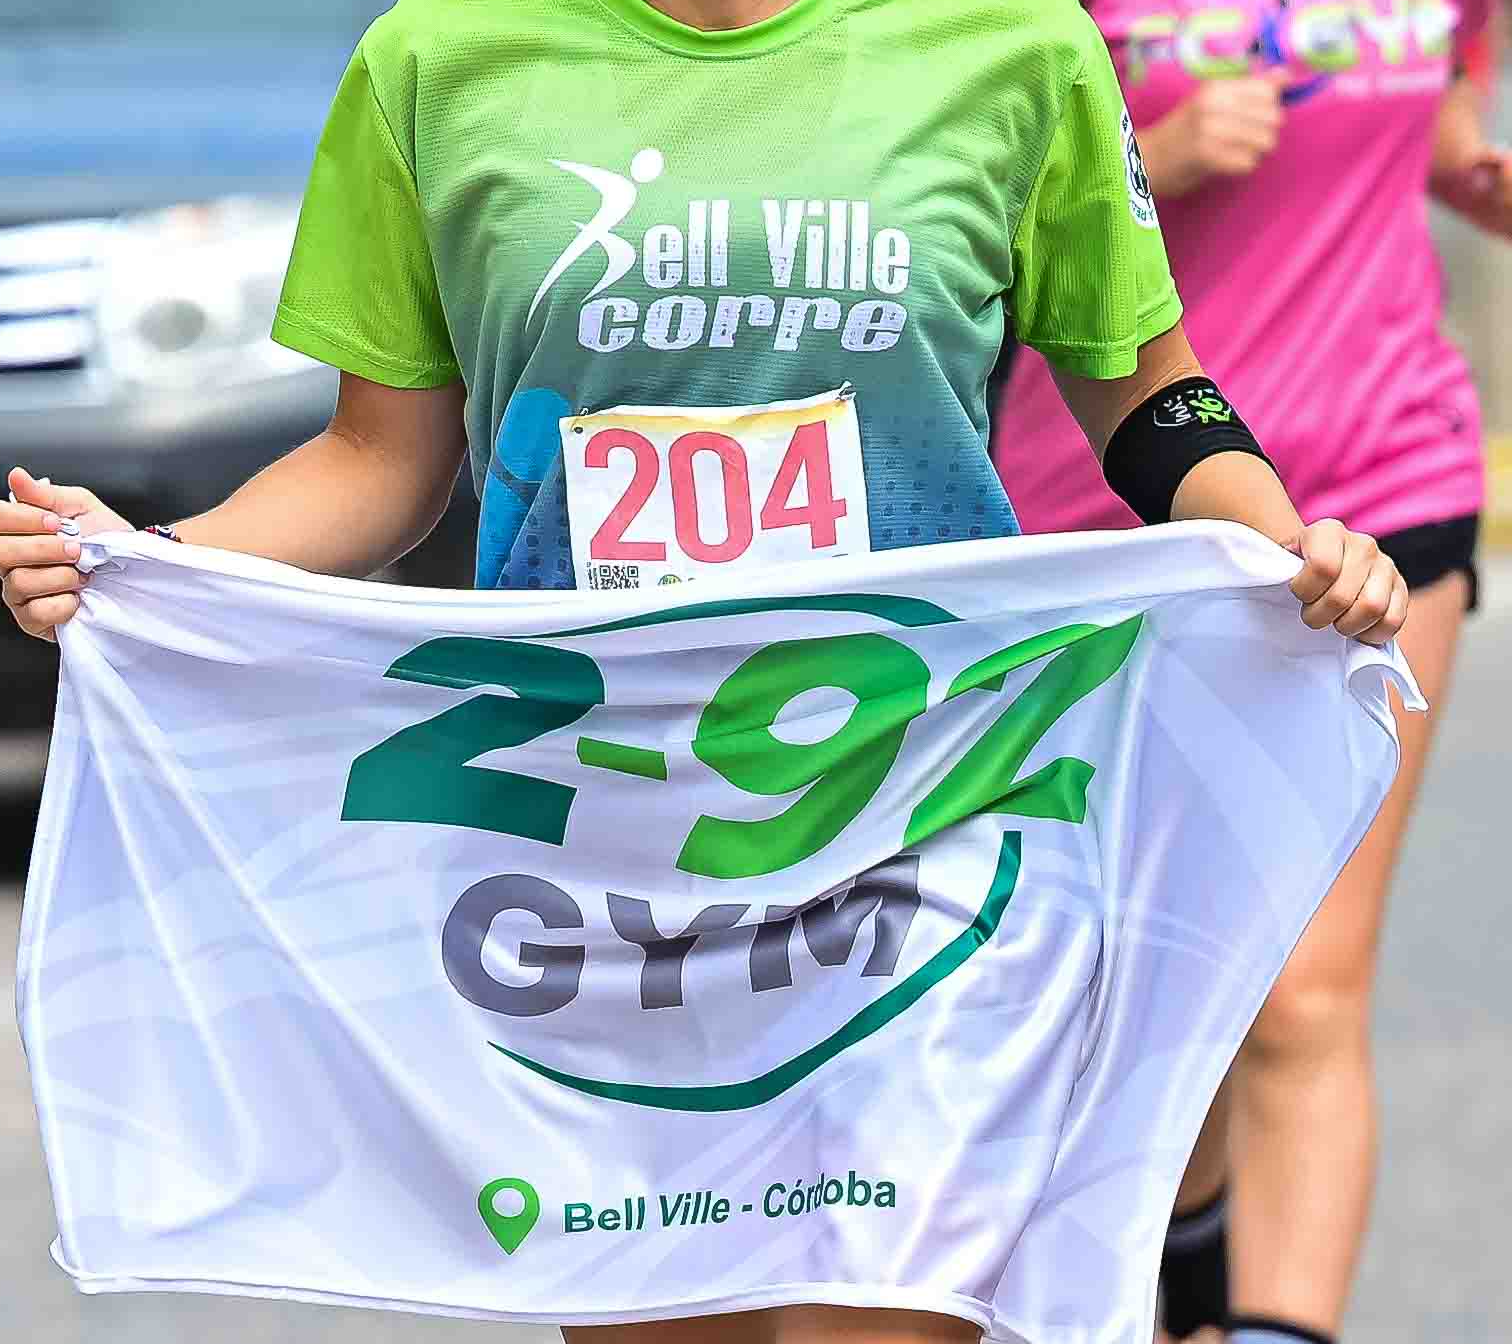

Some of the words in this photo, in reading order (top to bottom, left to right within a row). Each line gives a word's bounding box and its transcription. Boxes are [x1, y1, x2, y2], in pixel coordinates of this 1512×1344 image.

[761, 198, 912, 296] Ville
[577, 292, 908, 353] corre
[583, 419, 849, 565] 204
[340, 613, 1145, 880] 2-92
[440, 854, 922, 1019] GYM
[564, 1196, 646, 1234] Bell
[658, 1190, 730, 1227] Ville
[763, 1169, 896, 1219] Córdoba
